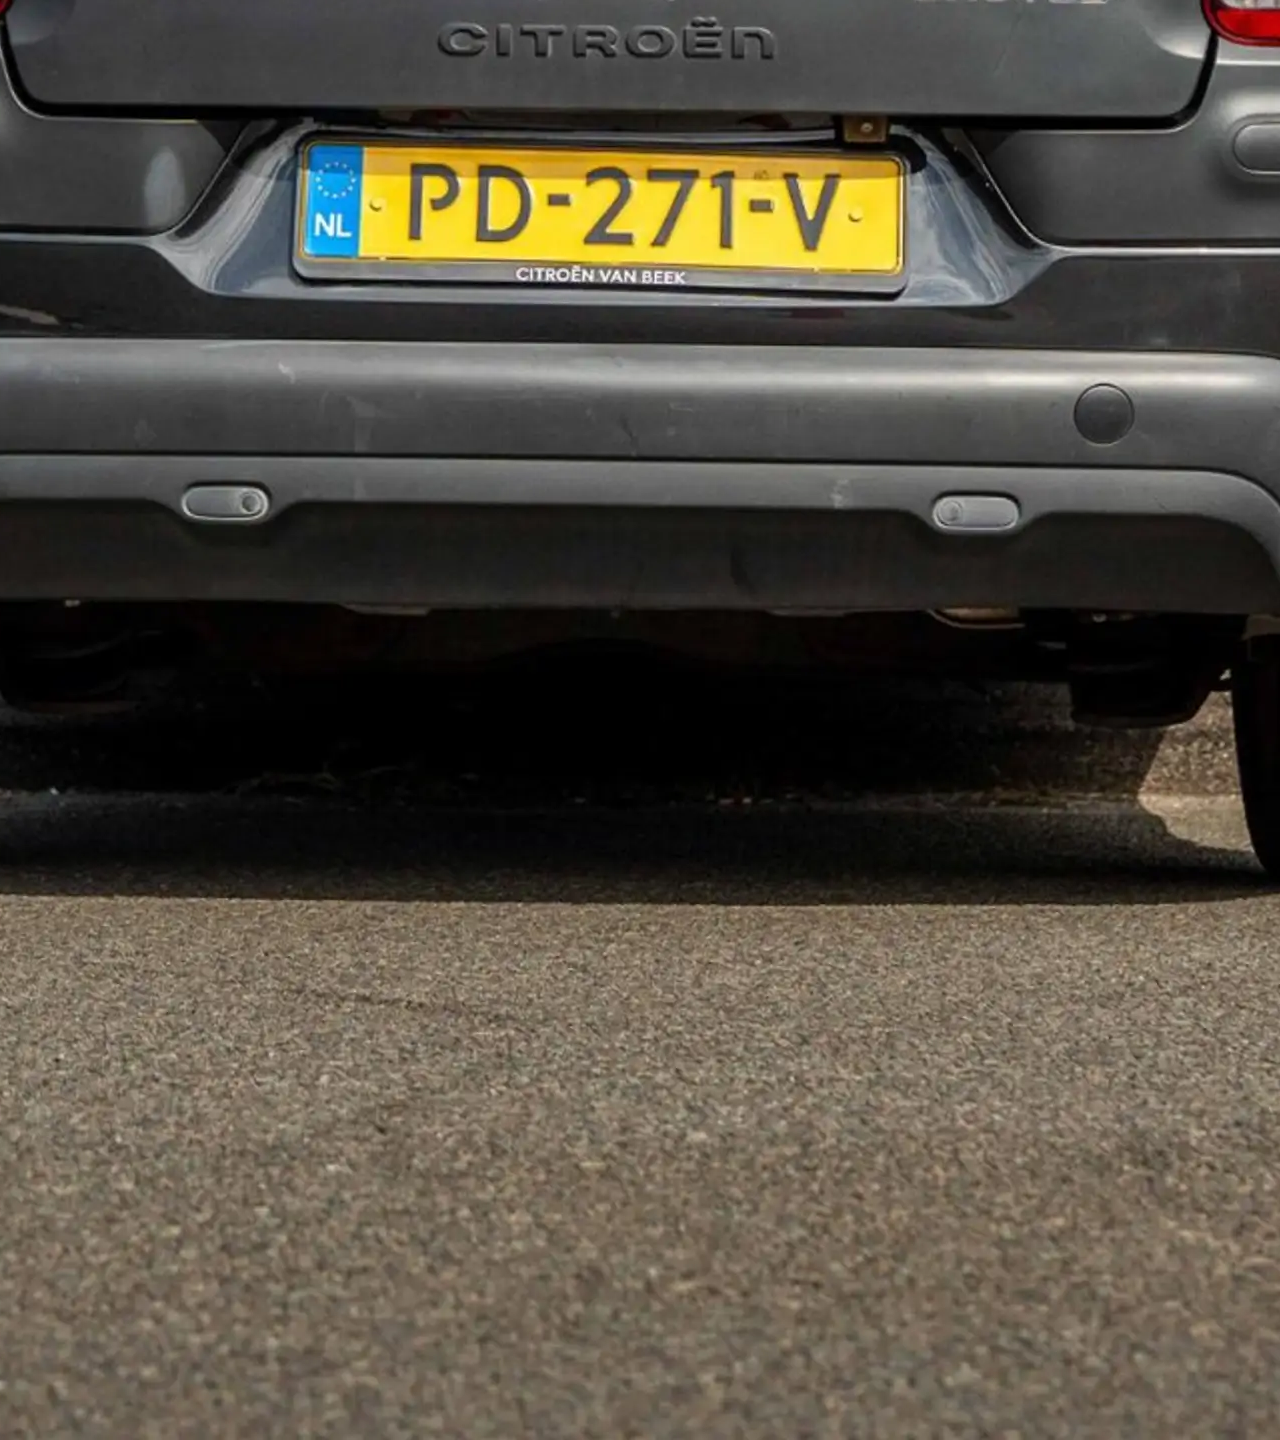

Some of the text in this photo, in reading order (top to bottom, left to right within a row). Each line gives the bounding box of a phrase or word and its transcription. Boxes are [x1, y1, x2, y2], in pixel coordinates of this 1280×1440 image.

[406, 161, 843, 252] PD-271-V
[313, 212, 353, 238] NL
[515, 264, 687, 285] CITROËN VAN BEEK
